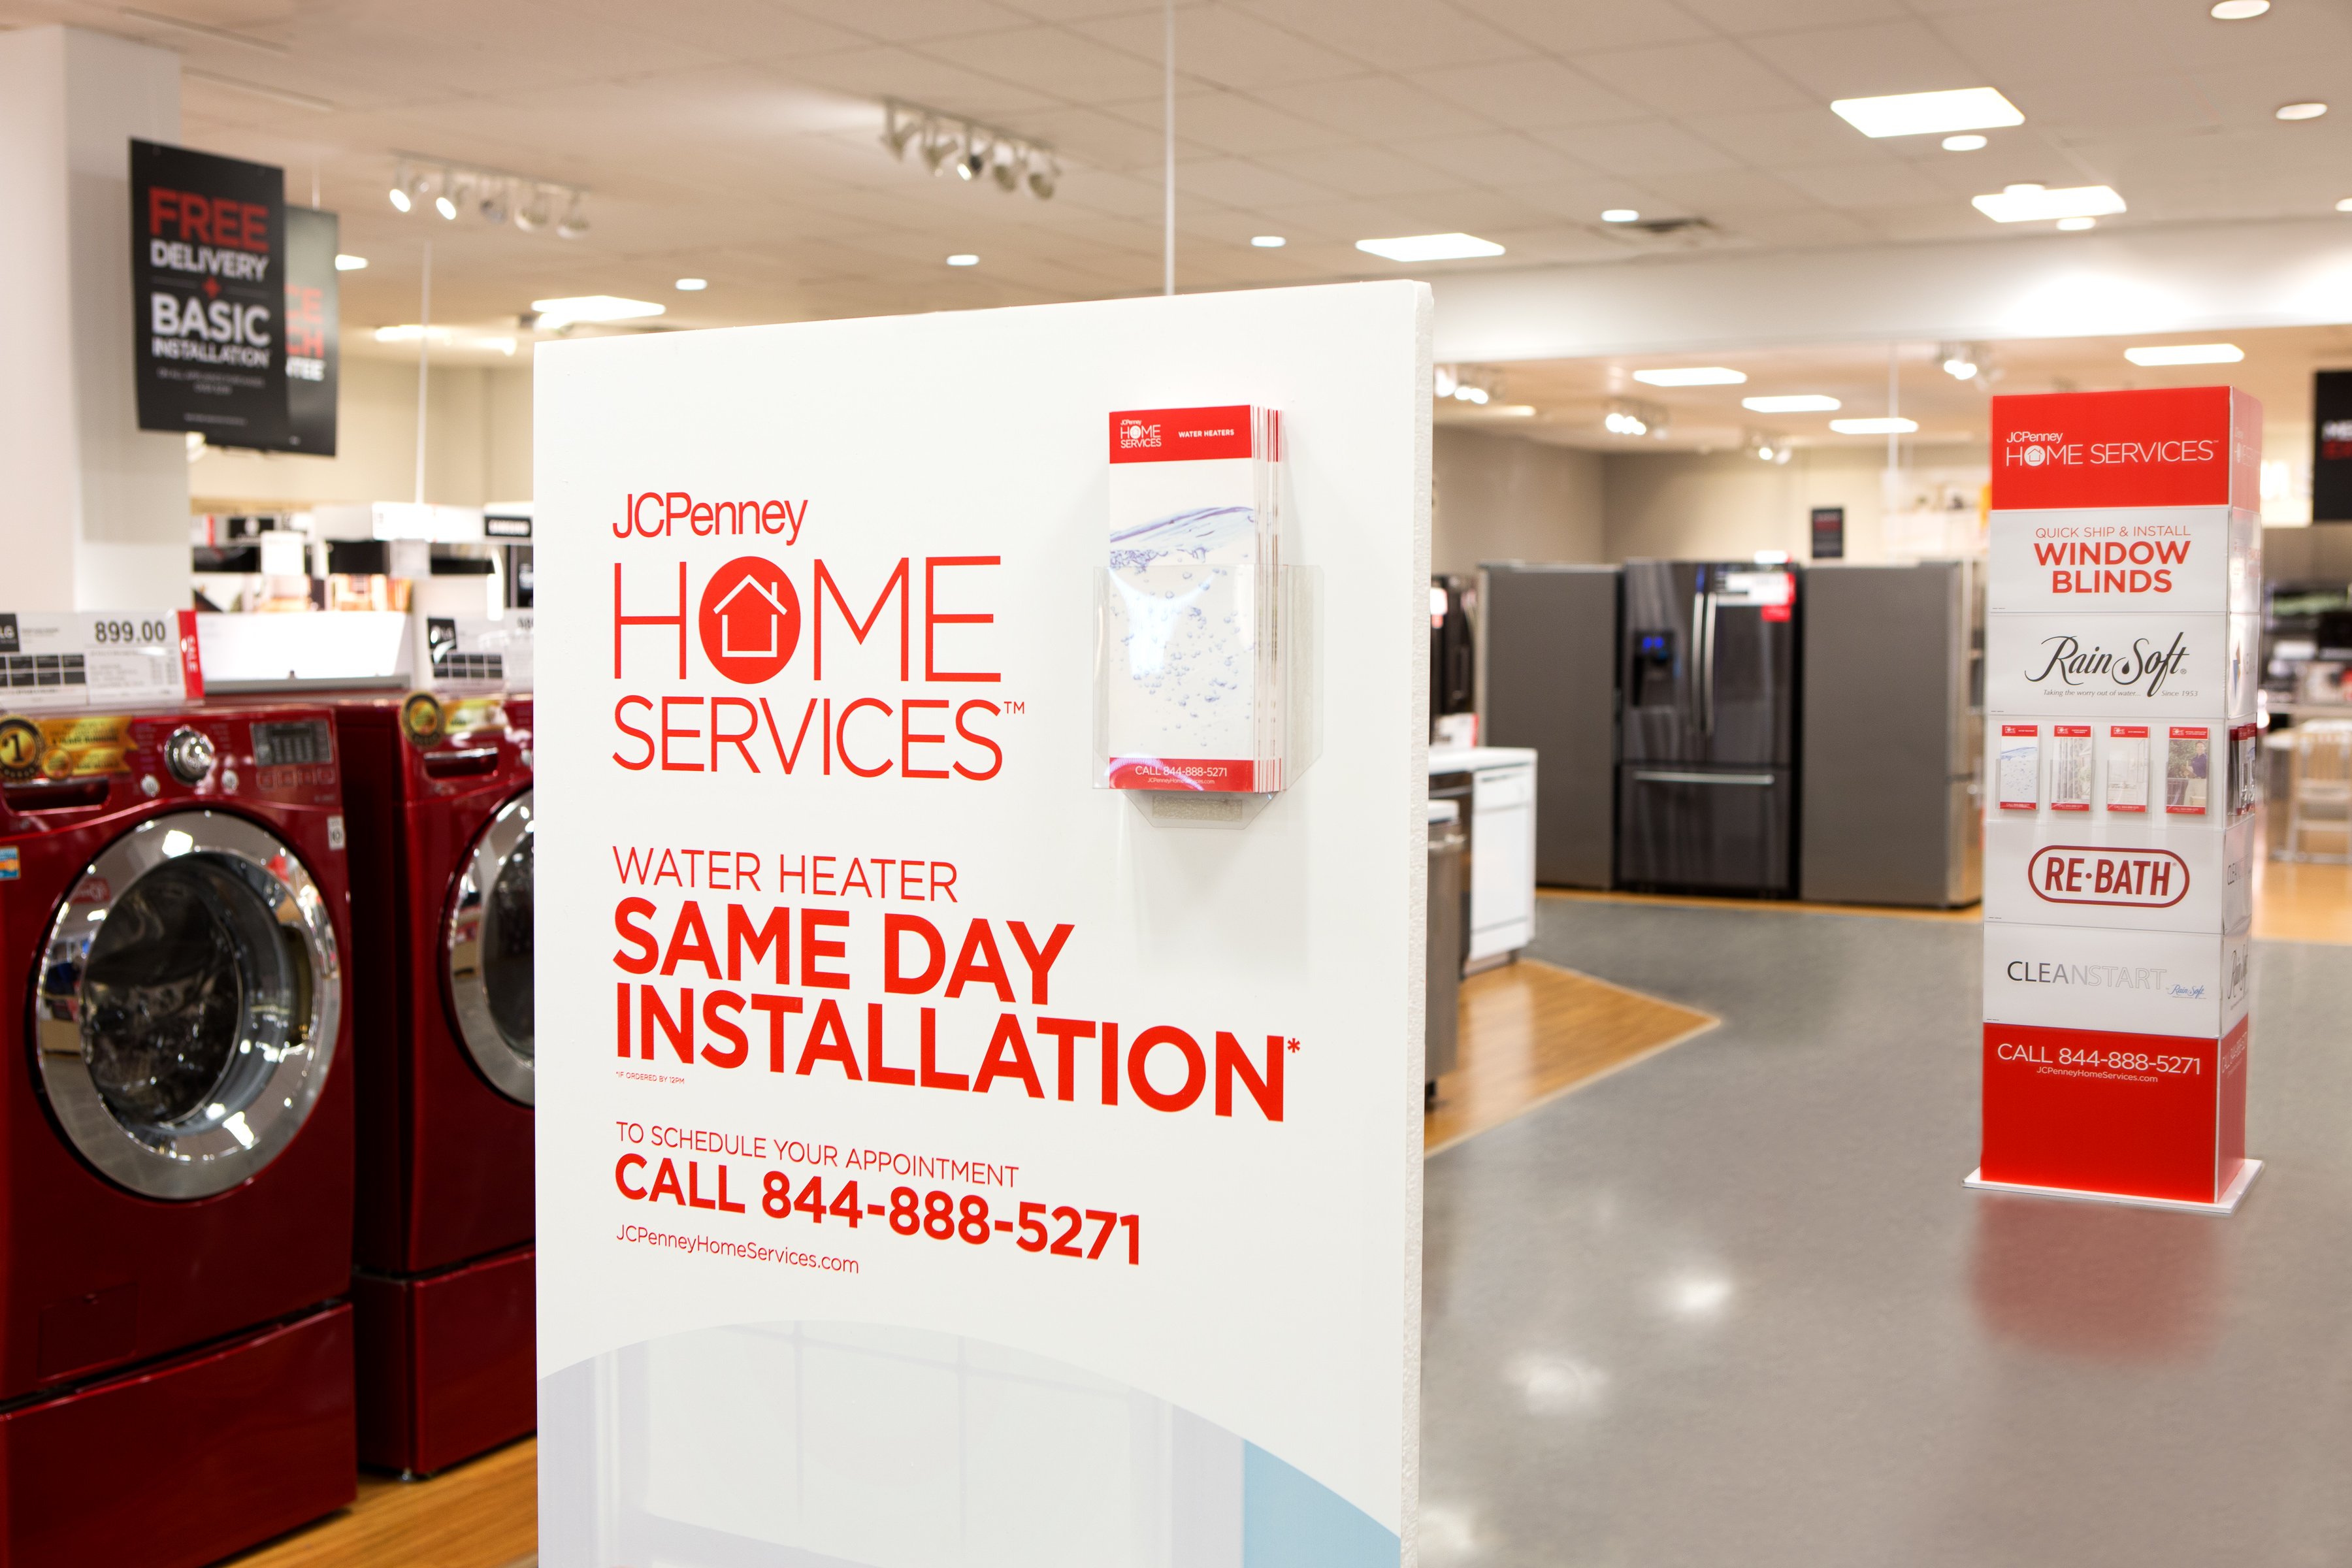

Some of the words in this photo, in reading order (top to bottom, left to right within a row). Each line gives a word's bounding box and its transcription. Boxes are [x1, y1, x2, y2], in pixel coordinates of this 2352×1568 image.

[148, 186, 269, 253] FREE
[150, 238, 270, 282] DELIVERY
[151, 292, 271, 348] BASIC
[152, 338, 270, 368] INSTALLATION
[1120, 424, 1161, 440] HOME
[1120, 438, 1162, 449] SERVICES
[1178, 430, 1202, 438] WATER
[1204, 429, 1235, 437] HEATERS
[2006, 431, 2063, 444] JCPenney
[2006, 444, 2083, 466] HOME
[612, 492, 808, 546] JCPenney
[2035, 527, 2079, 538] QUICK
[2084, 527, 2115, 537] SHIP
[2119, 526, 2129, 537] &
[2134, 525, 2191, 536] INSTALL
[2034, 540, 2191, 566] WINDOW
[2052, 569, 2172, 593] BLINDS
[95, 620, 166, 643] 899.00
[614, 555, 1001, 684] HOME
[2025, 636, 2112, 685] Rain
[1135, 766, 1161, 776] CALL
[1163, 766, 1228, 777] 844-888-5271
[613, 846, 761, 892] WATER
[779, 855, 958, 902] HEATER
[613, 896, 850, 989] SAME
[884, 913, 1075, 1005] DAY
[2007, 961, 2167, 990] CLEANSTART
[1997, 1043, 2053, 1064] CALL
[2059, 1048, 2200, 1075] 844-888-5271
[626, 1072, 657, 1082] ORDERED
[669, 1076, 685, 1085] 12PM
[2037, 1066, 2158, 1083] JCPenneyHomeServices.com
[616, 1121, 644, 1143] TO
[651, 1125, 766, 1159] SCHEDULE
[773, 1139, 838, 1168] YOUR
[845, 1149, 1019, 1188] APPOINTMENT
[615, 1153, 745, 1213] CALL
[762, 1171, 1140, 1265] 844-888-5271
[616, 1224, 859, 1274] JCPenneyHomeServices.com
